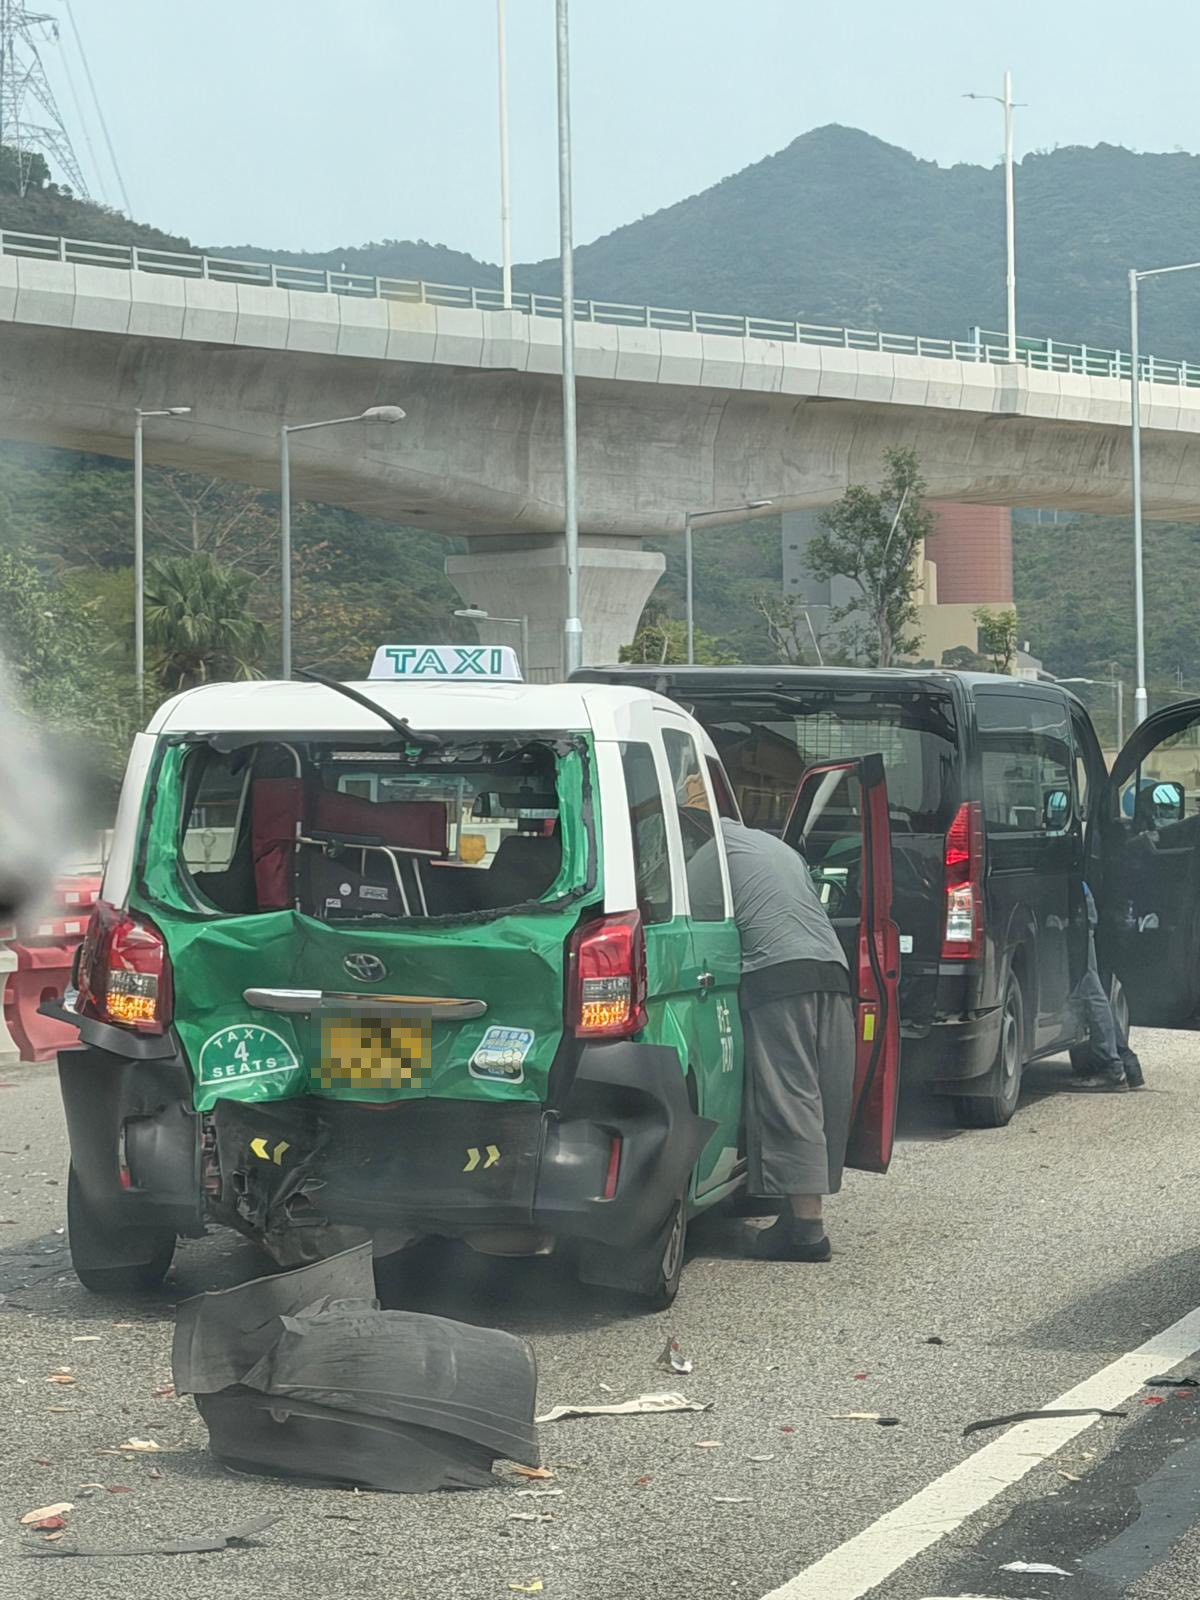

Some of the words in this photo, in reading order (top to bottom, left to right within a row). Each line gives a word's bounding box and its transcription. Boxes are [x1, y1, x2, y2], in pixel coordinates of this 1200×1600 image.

[385, 648, 502, 674] TAXI
[213, 1028, 266, 1049] TAXI
[234, 1040, 250, 1062] 4
[212, 1057, 277, 1078] SEATS
